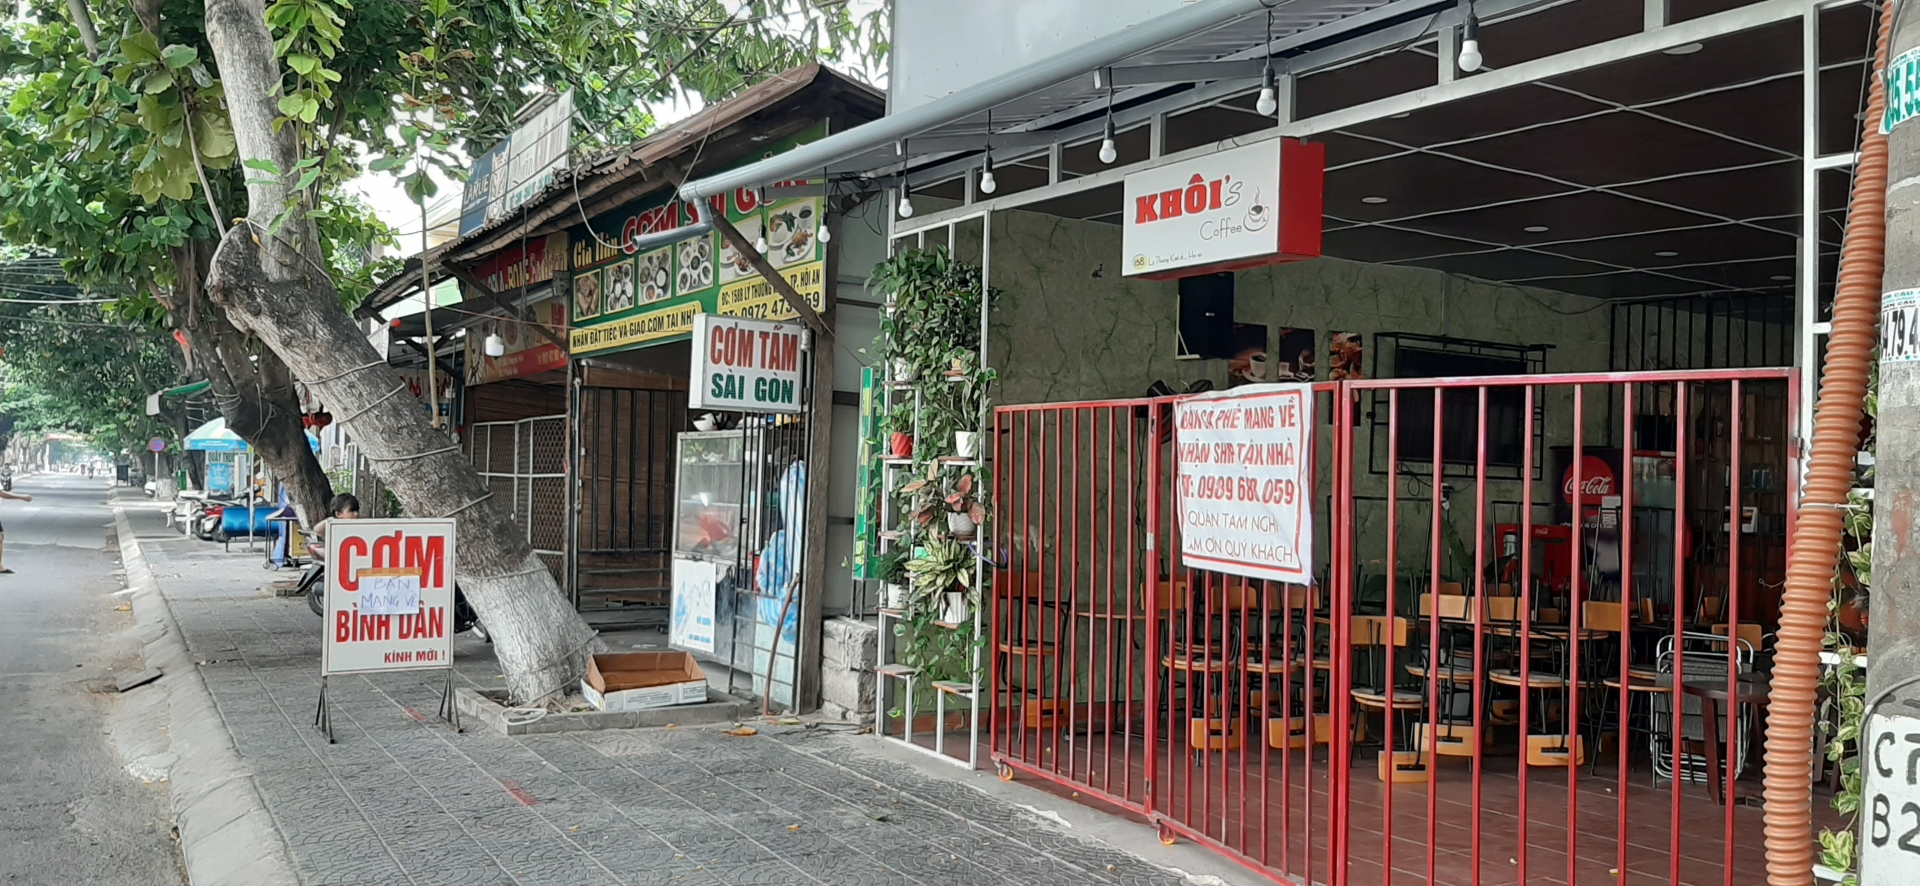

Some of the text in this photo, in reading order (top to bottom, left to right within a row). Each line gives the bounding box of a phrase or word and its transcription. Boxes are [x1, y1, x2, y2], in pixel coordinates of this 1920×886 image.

[1199, 216, 1243, 241] Coffee
[573, 238, 593, 269] Gia
[800, 267, 811, 291] HỘI
[812, 268, 821, 286] AN
[741, 302, 768, 319] 0972
[618, 321, 628, 339] VÀ
[629, 319, 647, 337] GIAO
[647, 314, 665, 333] CƠM
[666, 312, 679, 332] TẠI
[710, 321, 799, 373] CƠM TẤM
[711, 367, 795, 405] SÀI GÒN
[1215, 402, 1242, 430] PHÊ
[1243, 405, 1275, 430] MANG
[1278, 396, 1296, 428] VỀ
[1266, 436, 1295, 466] NHÀ
[1262, 477, 1295, 505] 059
[1187, 508, 1220, 528] QUÁN
[338, 530, 445, 592] CƠM
[1225, 538, 1248, 558] QUÝ
[1250, 541, 1293, 563] KHÁCH
[360, 592, 400, 609] MANG
[335, 599, 444, 643] BÌNH DÂN
[383, 649, 412, 664] KÍNH
[415, 647, 438, 662] MỜI
